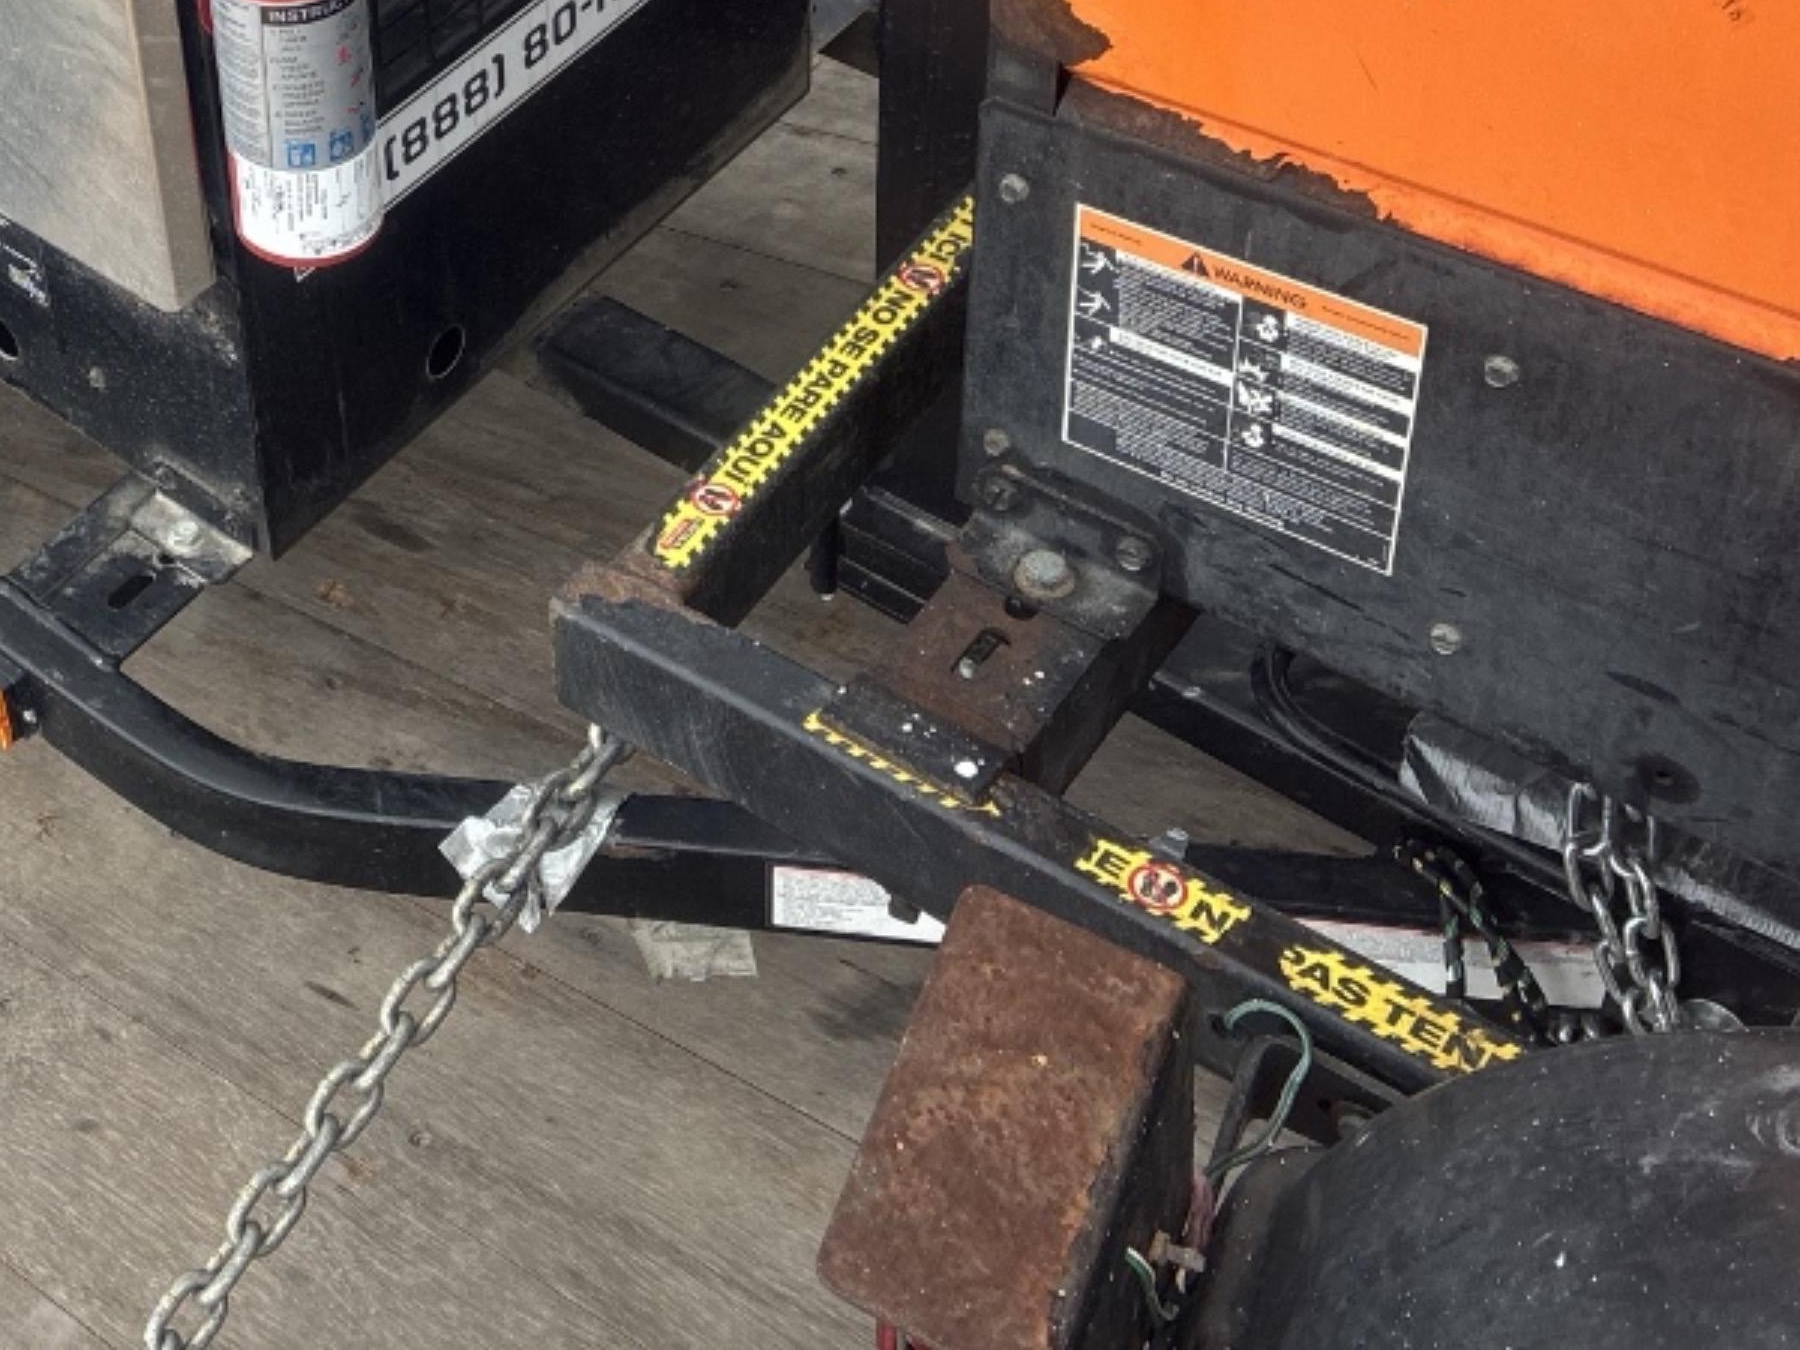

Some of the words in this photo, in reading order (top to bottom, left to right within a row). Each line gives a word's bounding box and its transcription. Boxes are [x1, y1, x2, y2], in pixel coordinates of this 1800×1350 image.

[872, 289, 913, 325] NO
[1213, 264, 1307, 311] WARNING
[839, 326, 880, 361] SE
[780, 358, 850, 424] PARE
